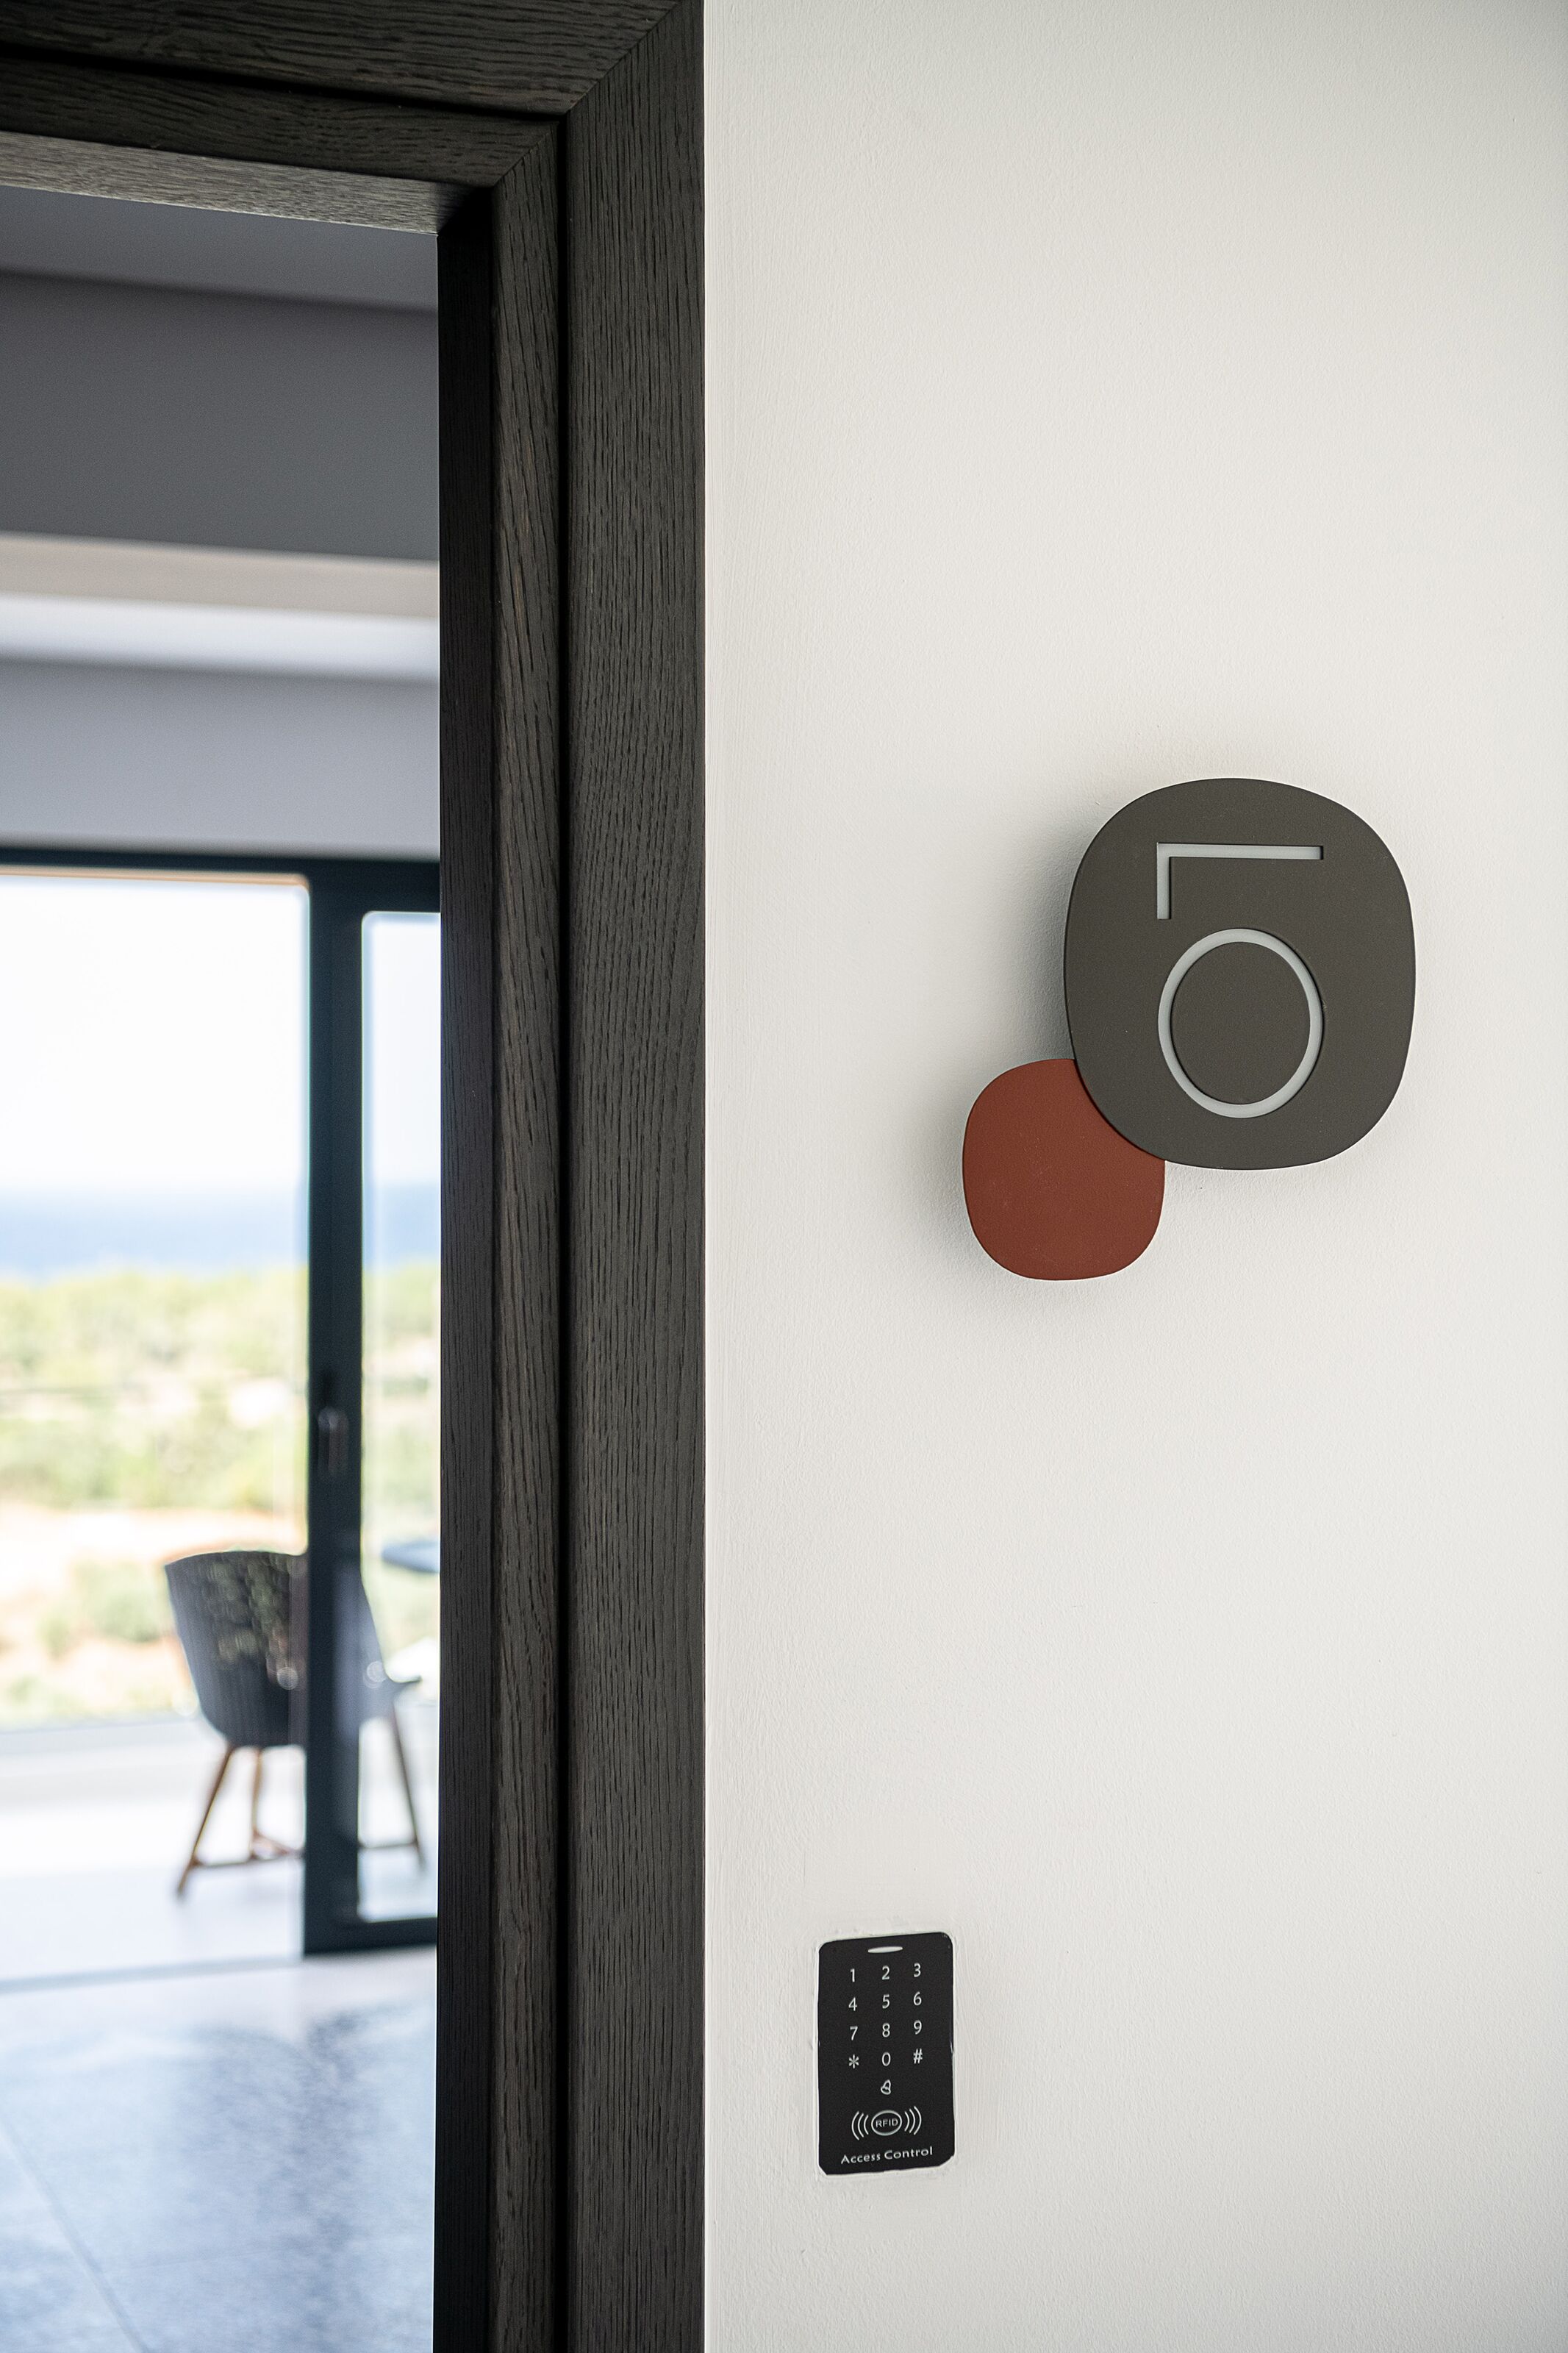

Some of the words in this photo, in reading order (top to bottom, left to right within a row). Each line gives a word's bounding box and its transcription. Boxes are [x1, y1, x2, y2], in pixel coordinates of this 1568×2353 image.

[1156, 842, 1324, 1118] 5
[850, 1968, 856, 1982] 1
[881, 1965, 890, 1980] 2
[913, 1962, 921, 1978] 3
[848, 1996, 858, 2012] 4
[881, 1993, 890, 2009] 5
[913, 1990, 922, 2006] 6
[849, 2025, 859, 2041] 7
[881, 2022, 890, 2038] 8
[913, 2019, 923, 2035] 9
[881, 2052, 891, 2067] 0
[913, 2048, 923, 2065] #
[876, 2118, 898, 2128] RFID
[840, 2153, 881, 2165] Access
[884, 2146, 933, 2160] Control
